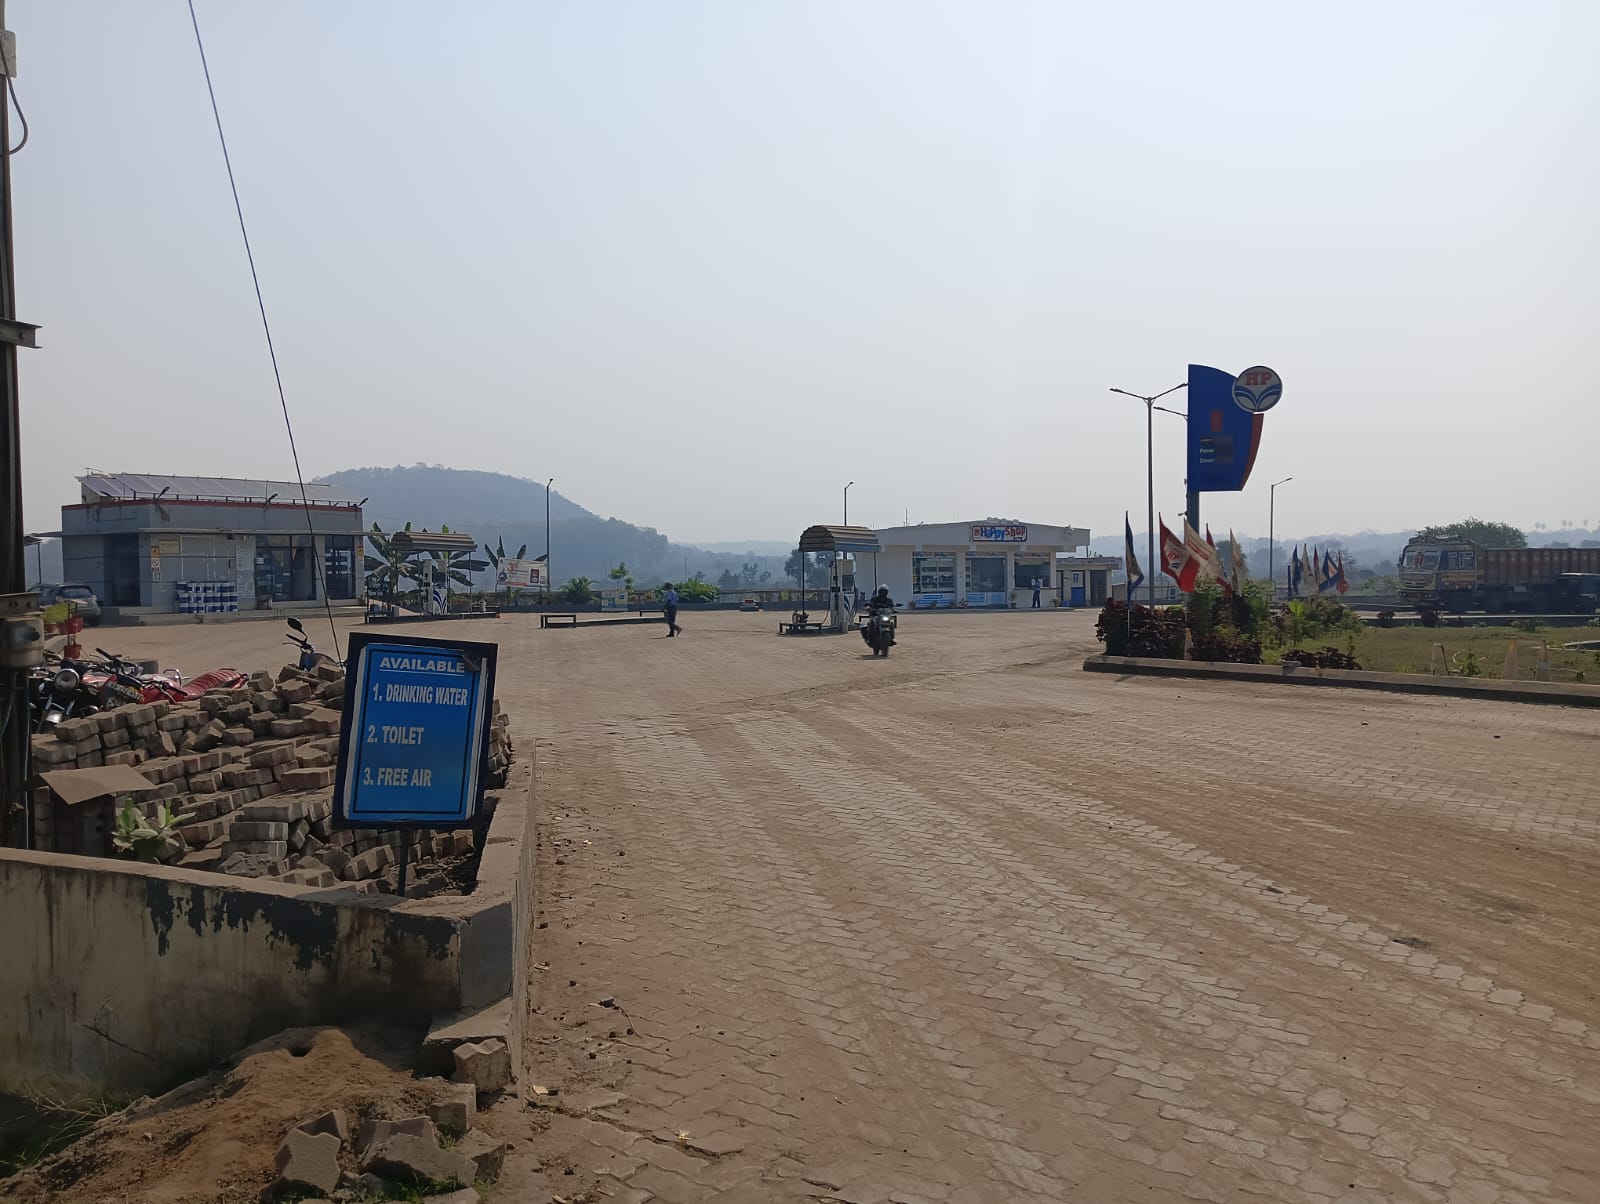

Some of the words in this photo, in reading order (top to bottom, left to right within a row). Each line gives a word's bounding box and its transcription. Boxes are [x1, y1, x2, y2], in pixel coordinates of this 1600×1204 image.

[1246, 372, 1271, 386] HP
[379, 657, 465, 673] AVAILABLE
[372, 682, 383, 701] 1.
[386, 684, 433, 704] DRINKING
[435, 687, 468, 706] WATER
[367, 725, 378, 743] 2.
[382, 725, 424, 745] TOILET
[363, 767, 374, 785] 3.
[377, 767, 409, 786] FREE
[410, 769, 432, 787] AIR
